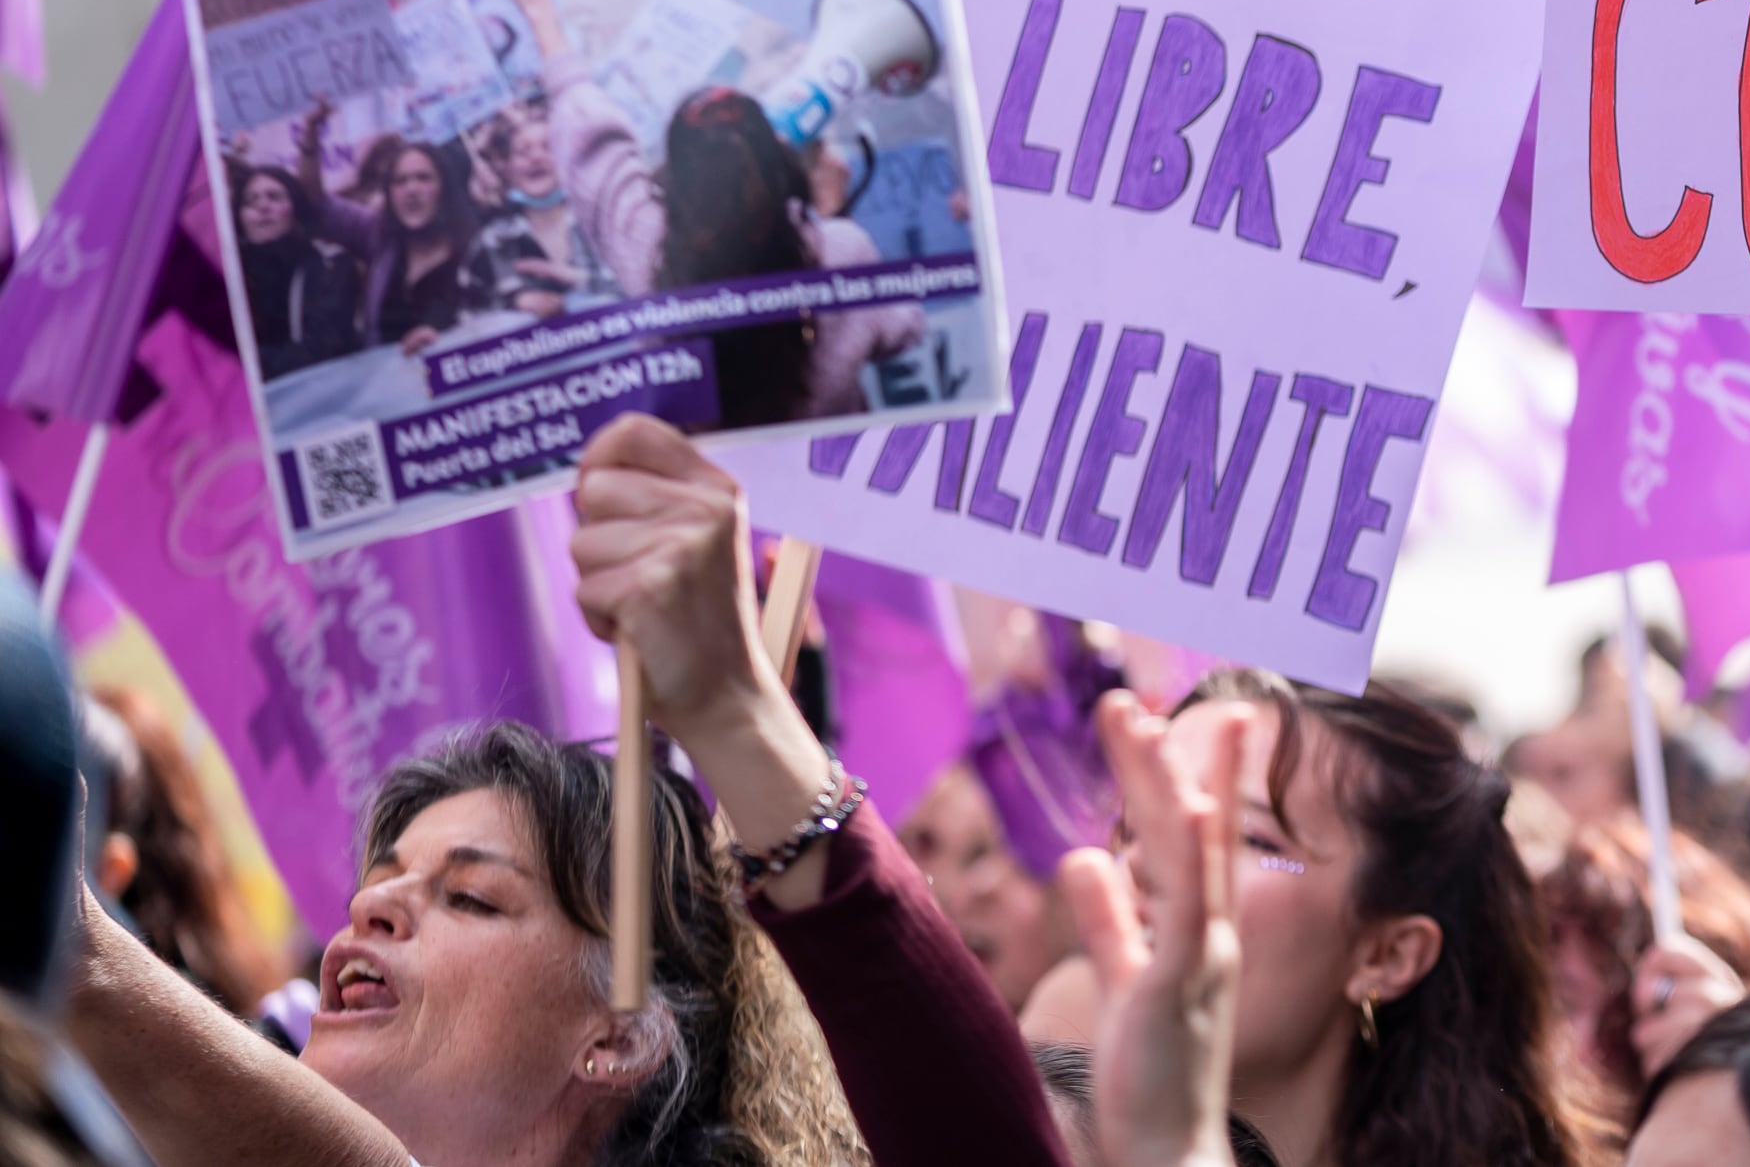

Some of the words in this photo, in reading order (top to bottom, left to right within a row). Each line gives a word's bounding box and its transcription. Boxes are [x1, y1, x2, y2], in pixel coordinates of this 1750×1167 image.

[440, 355, 466, 385] El
[469, 322, 598, 380] capitalismo
[629, 287, 747, 333] violencia
[749, 276, 834, 315] contra
[837, 269, 873, 302] las
[395, 356, 644, 458] MANIFESTACIÓN
[644, 349, 702, 387] 12h
[402, 444, 489, 490] Puerta
[492, 431, 534, 465] del
[537, 417, 582, 454] Sol
[808, 310, 1436, 634] LIENTE
